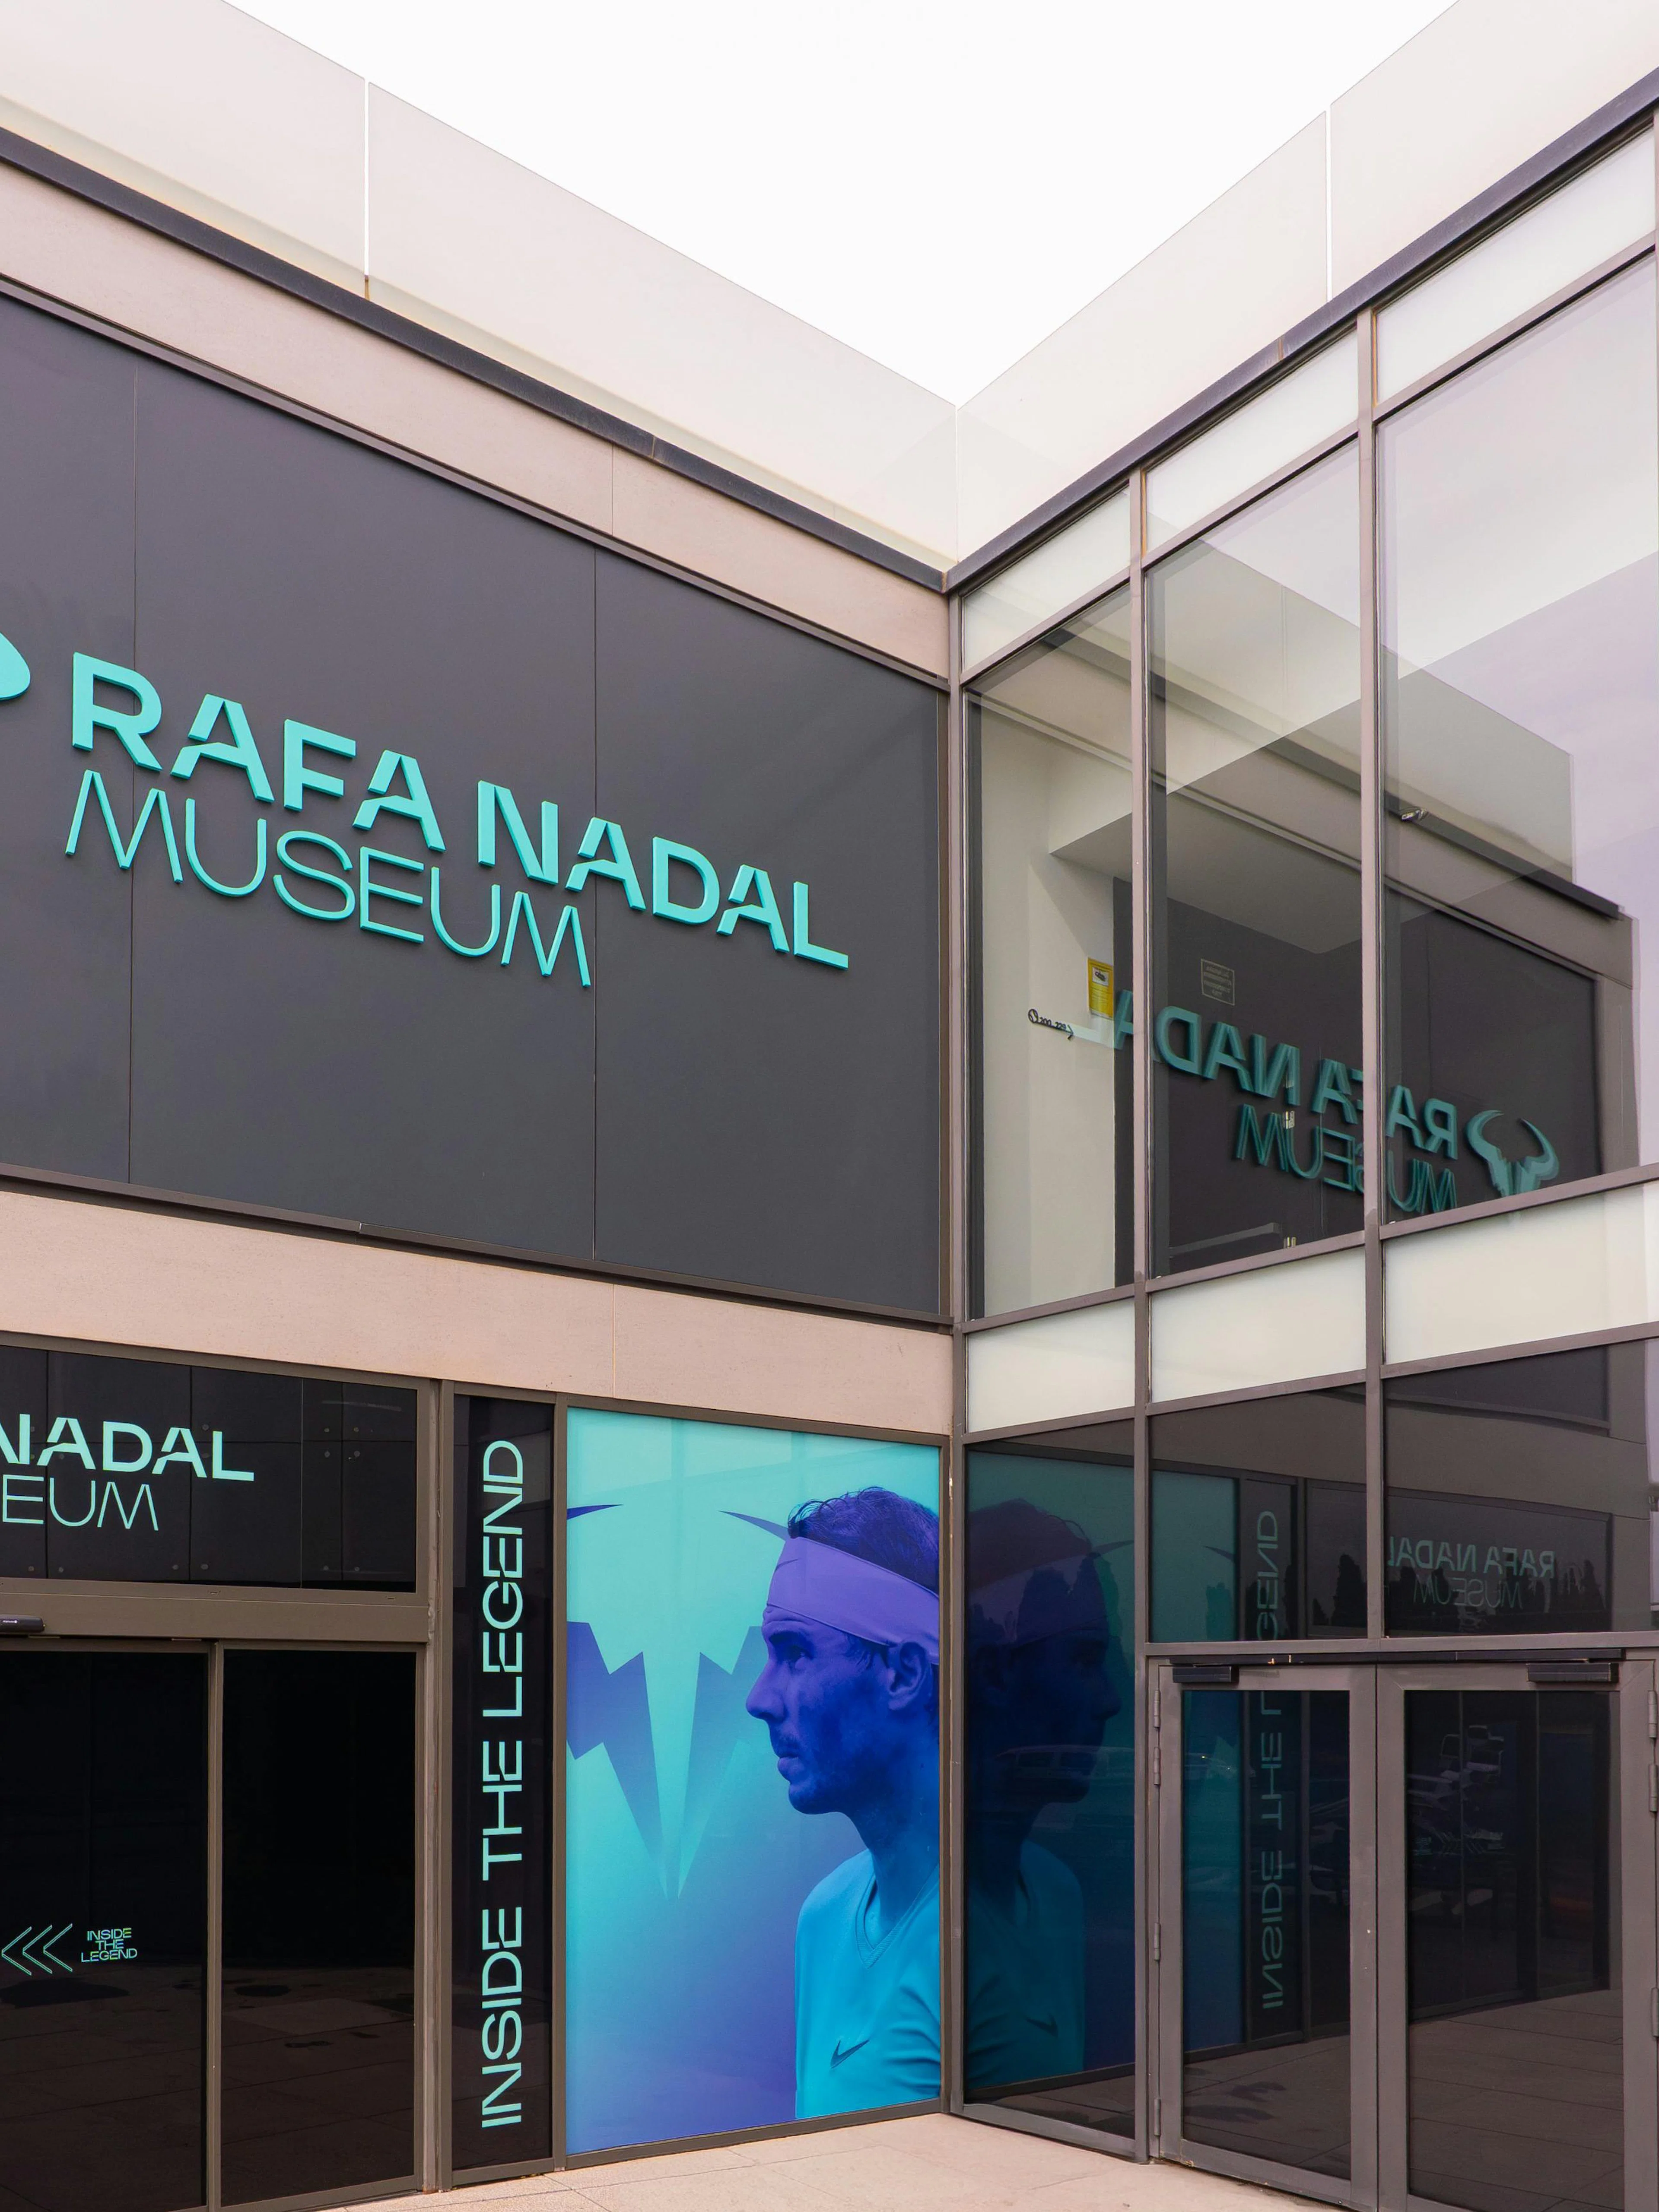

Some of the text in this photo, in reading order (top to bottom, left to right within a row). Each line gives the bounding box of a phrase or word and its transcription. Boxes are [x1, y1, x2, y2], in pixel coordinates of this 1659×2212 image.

[72, 651, 849, 970] RAFA NADAL
[65, 769, 591, 988] MUSEUM
[482, 1440, 523, 2128] INSIDE THE LEGEND
[81, 1948, 138, 1963] LEGEND
[87, 1927, 132, 1941] INSIDE
[95, 1939, 124, 1951] THE
